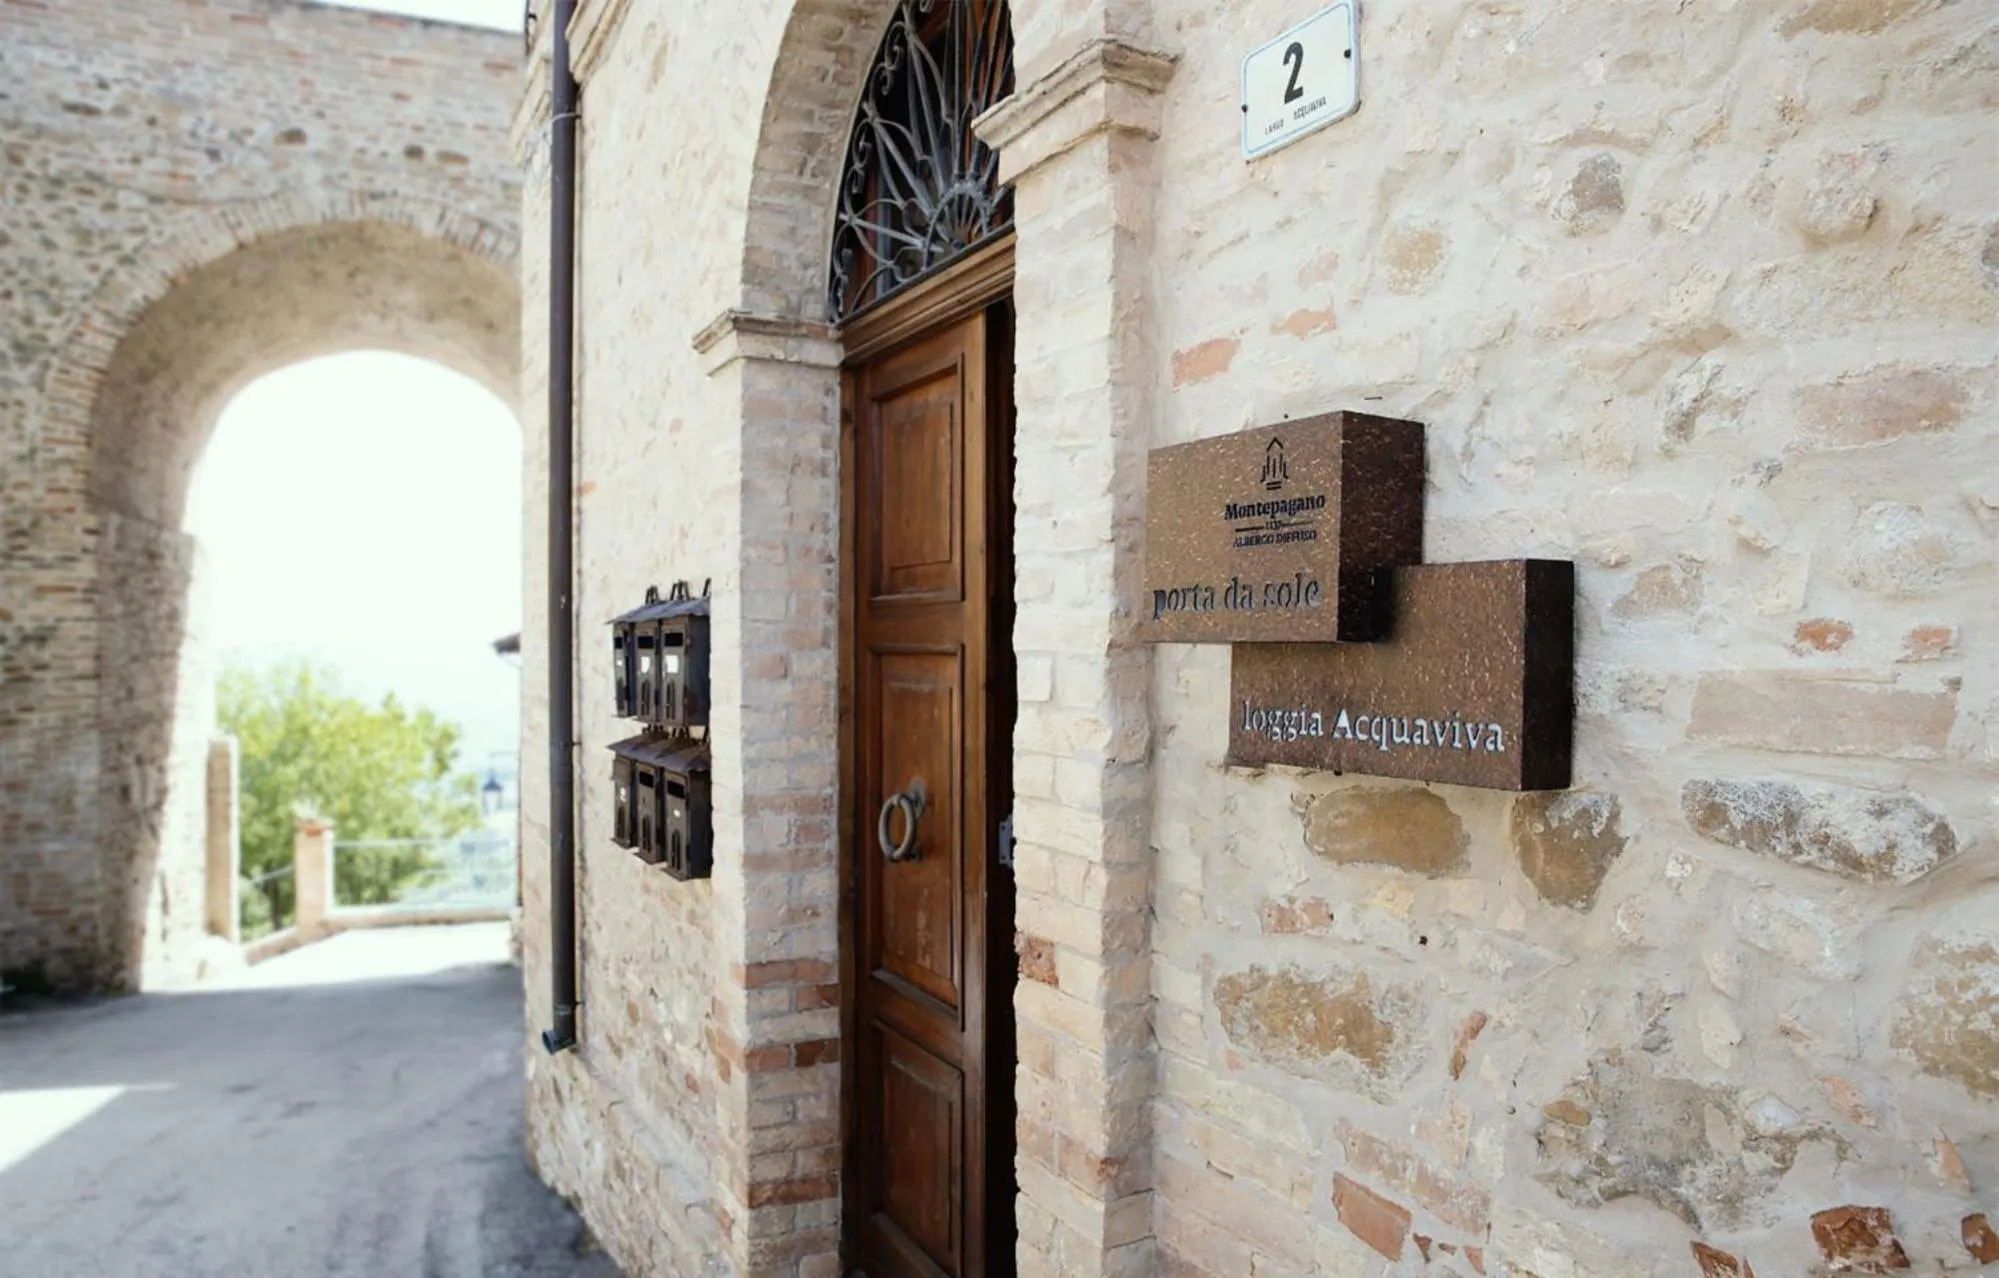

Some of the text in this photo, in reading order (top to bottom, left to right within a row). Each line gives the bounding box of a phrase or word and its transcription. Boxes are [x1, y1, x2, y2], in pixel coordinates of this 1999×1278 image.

[1283, 42, 1304, 104] 2
[1224, 495, 1325, 519] Montepagano
[1234, 533, 1274, 547] ALBERGO
[1153, 572, 1320, 620] porta da sole
[1244, 700, 1505, 752] loggia Acquaviva
